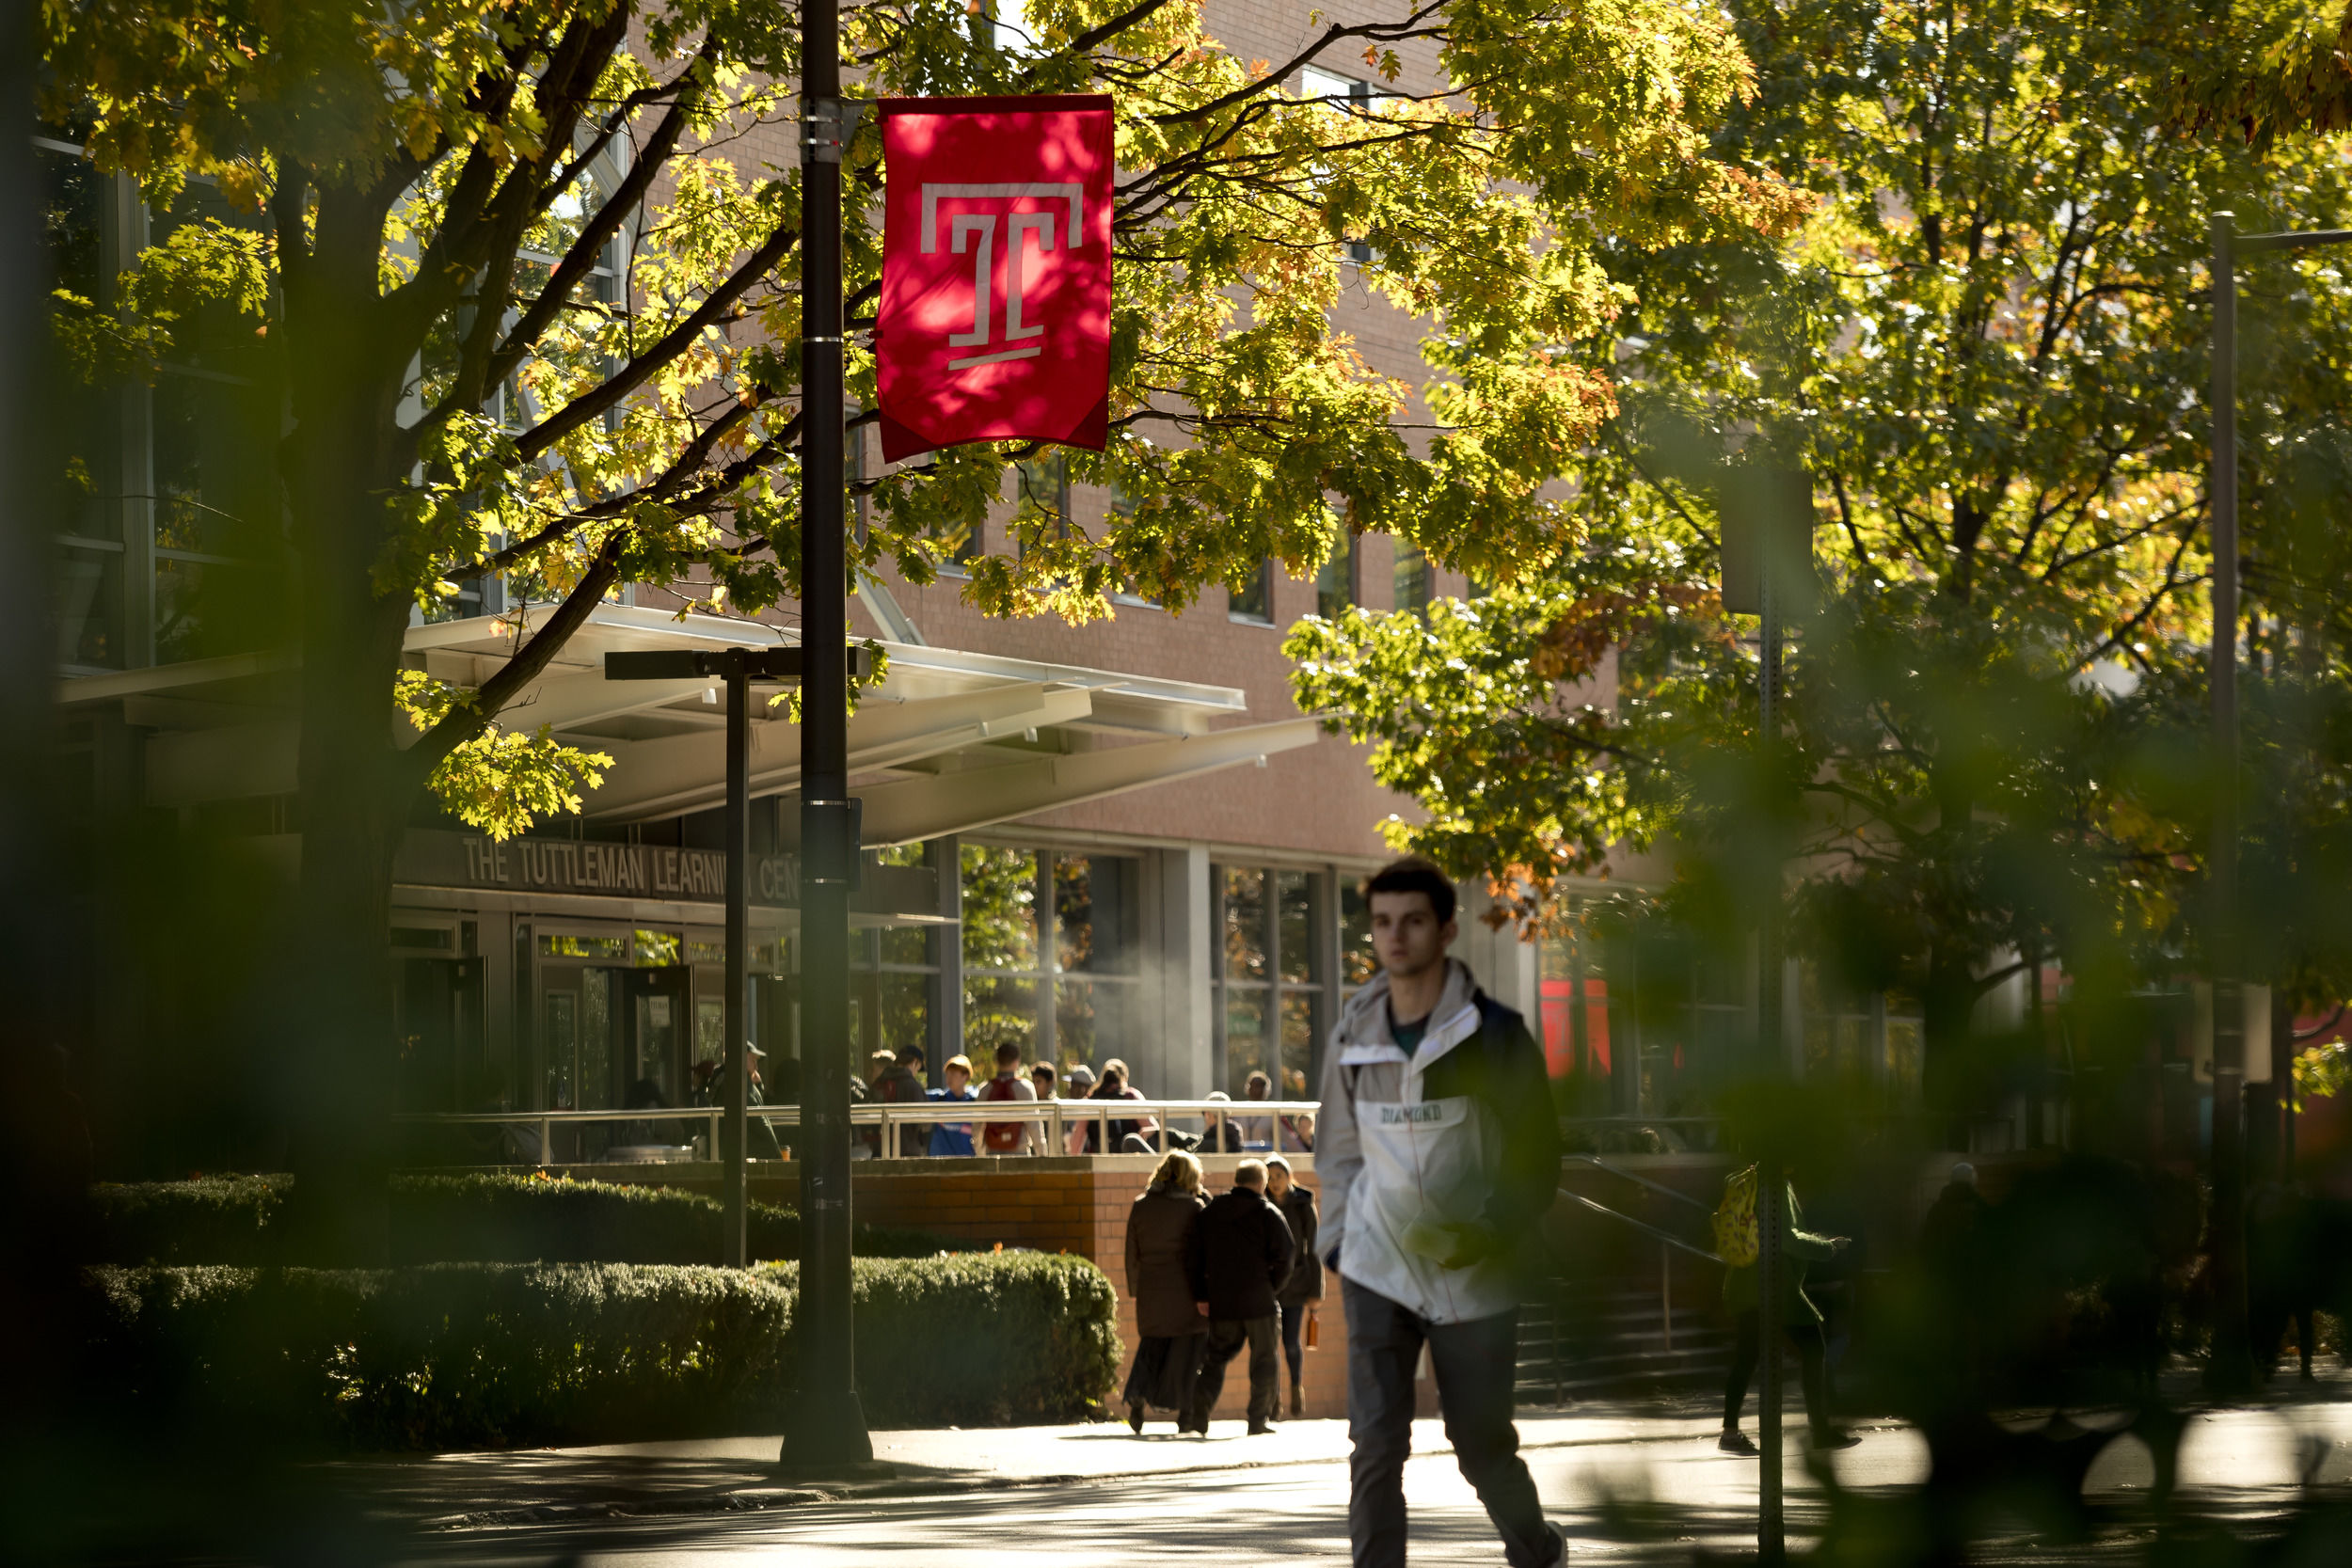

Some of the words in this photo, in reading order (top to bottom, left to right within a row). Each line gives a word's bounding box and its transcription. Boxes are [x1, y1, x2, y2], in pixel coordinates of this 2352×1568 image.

[462, 836, 510, 883] THE
[517, 840, 645, 890] TUTTLEMAN
[652, 847, 753, 897] LEARNI
[759, 858, 802, 900] CEN
[1381, 1104, 1442, 1125] DIAMOND
